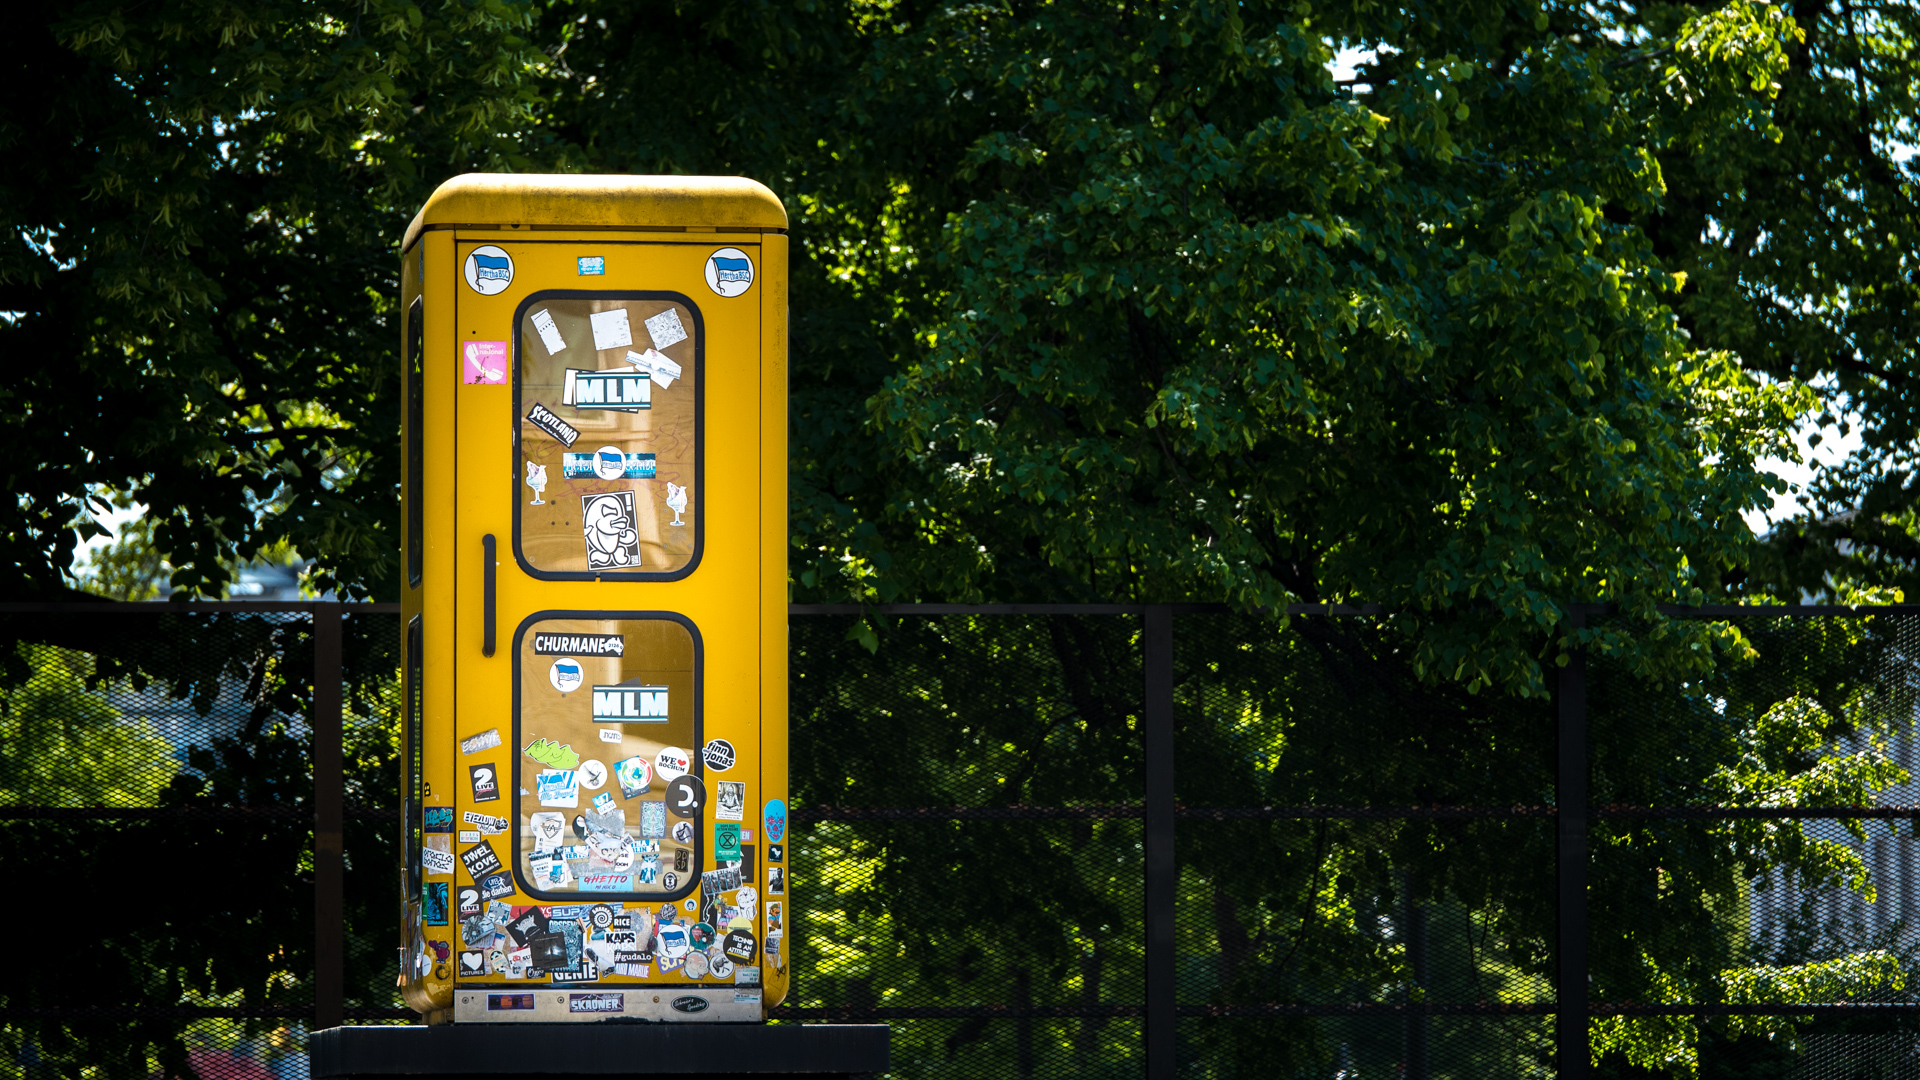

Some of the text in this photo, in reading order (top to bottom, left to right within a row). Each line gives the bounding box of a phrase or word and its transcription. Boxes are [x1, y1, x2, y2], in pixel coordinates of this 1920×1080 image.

[479, 268, 509, 280] Hertha BSC
[719, 271, 750, 281] Hertha BSC
[577, 379, 651, 403] MLM
[528, 404, 578, 444] SCOTLAND
[535, 636, 606, 653] CHURMANE
[593, 692, 668, 716] MLM
[707, 742, 728, 755] finn
[660, 755, 677, 764] WE
[705, 752, 735, 767] jonas
[658, 762, 686, 773] BOCHUM
[474, 768, 493, 787] 2
[468, 854, 497, 875] KOVE
[584, 875, 628, 884] GHETTO
[460, 889, 479, 907] 2
[614, 918, 630, 926] RICE
[606, 932, 635, 944] KAPS
